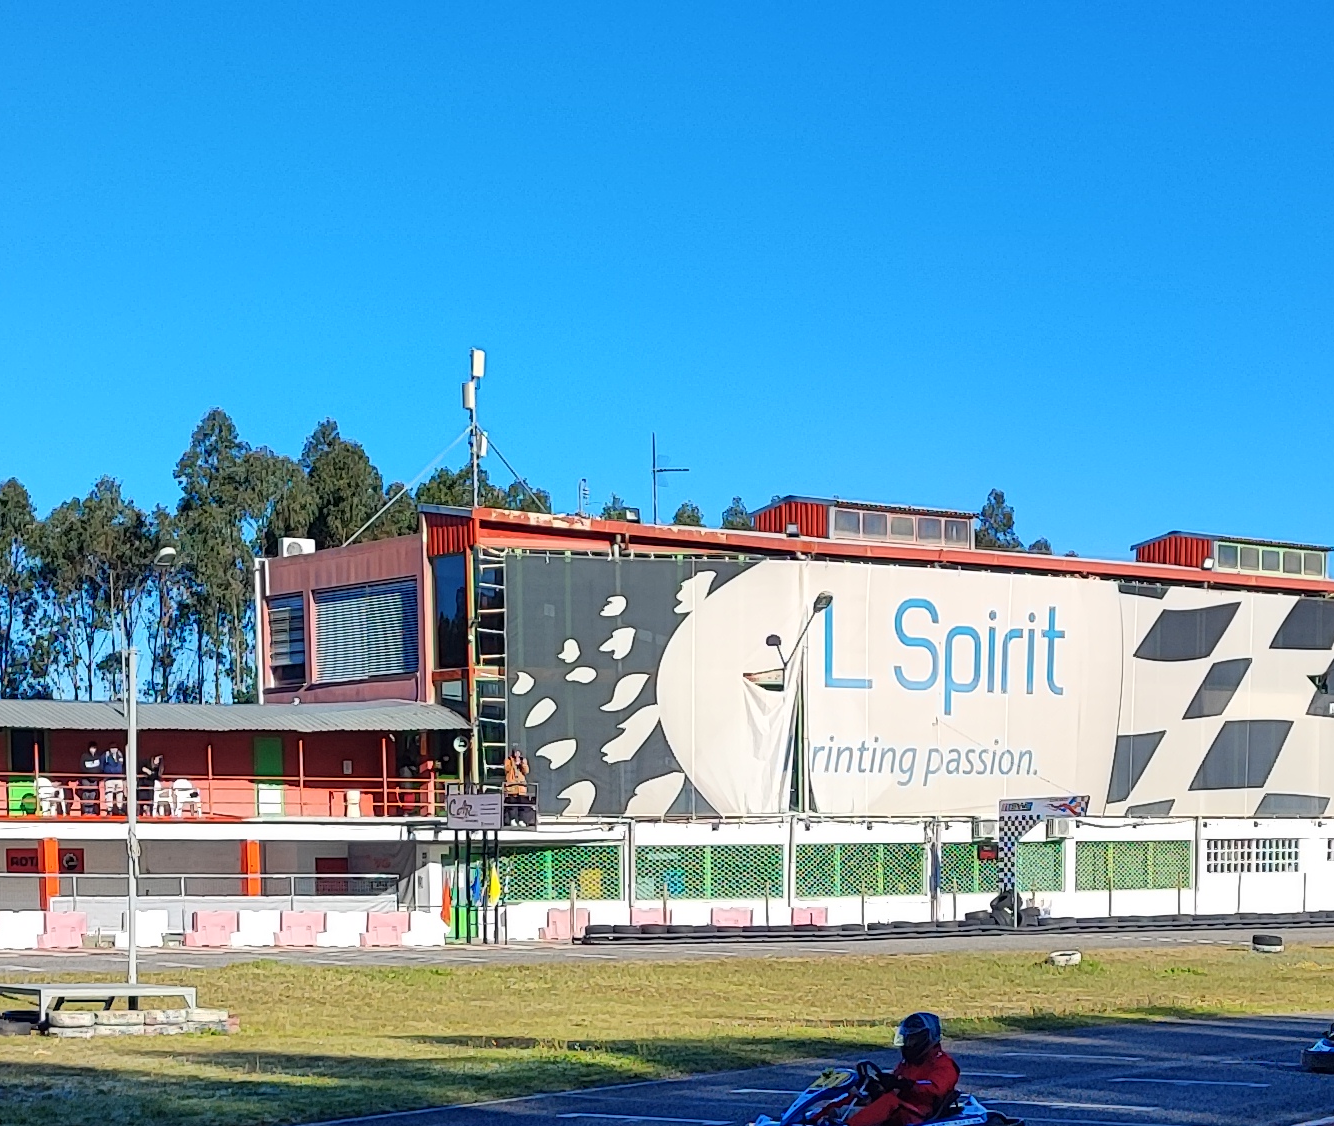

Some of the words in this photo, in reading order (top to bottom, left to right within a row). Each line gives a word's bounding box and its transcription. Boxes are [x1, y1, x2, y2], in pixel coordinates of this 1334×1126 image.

[825, 599, 873, 688] L
[893, 597, 1066, 716] Spirit
[783, 733, 918, 787] rinting
[923, 738, 1039, 787] passion.
